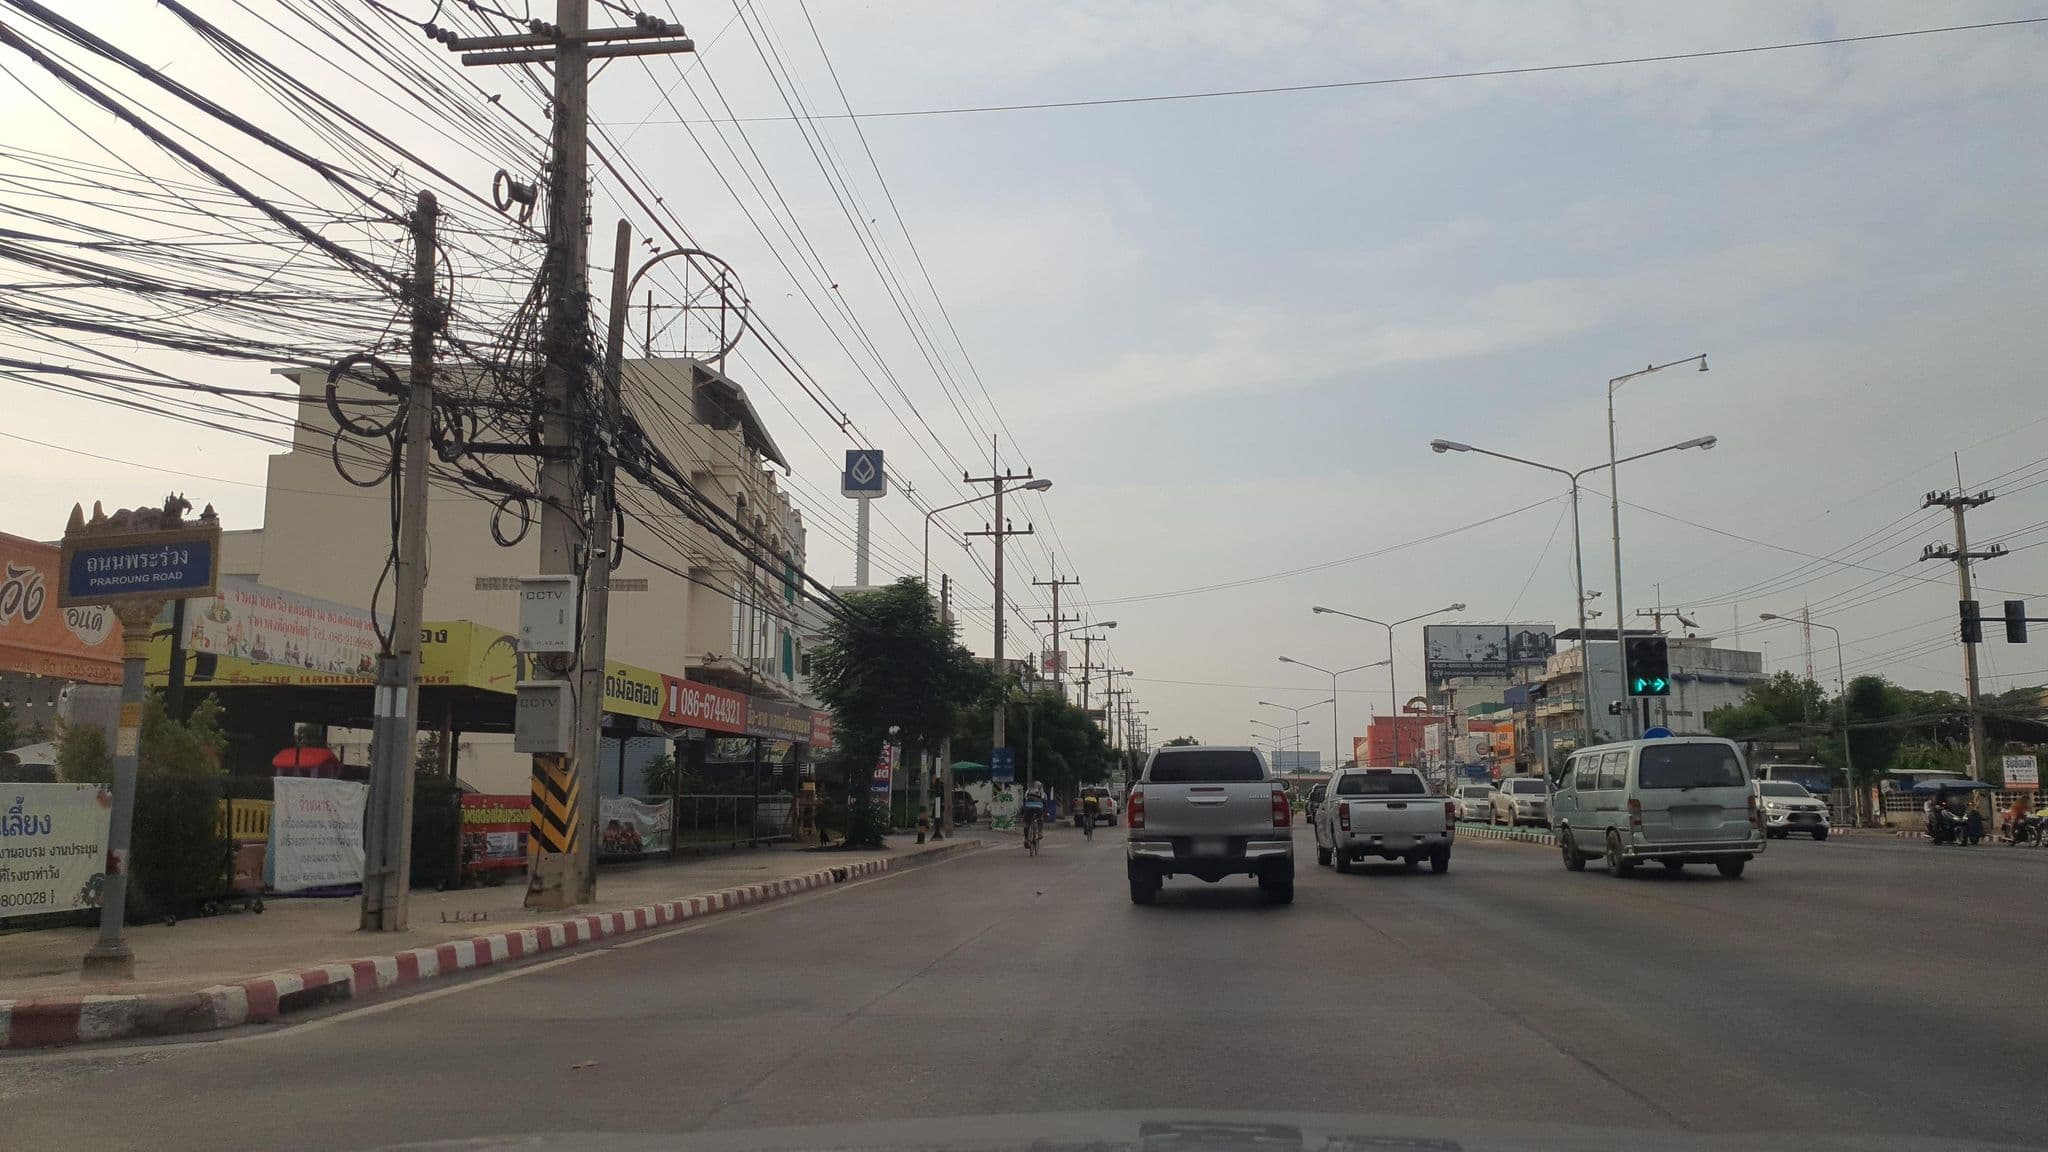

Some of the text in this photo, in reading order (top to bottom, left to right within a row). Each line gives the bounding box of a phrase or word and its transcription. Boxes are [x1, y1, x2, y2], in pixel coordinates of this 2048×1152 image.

[87, 546, 189, 572] ถนนพระร่วง
[90, 571, 183, 586] PRAROUNG ROAD
[526, 591, 563, 600] CCTV
[520, 699, 555, 708] CCTV
[680, 688, 741, 725] 086-6744321
[0, 796, 51, 837] เลี้ยง
[49, 844, 98, 859] งานประชุม
[0, 892, 46, 908] 800028
